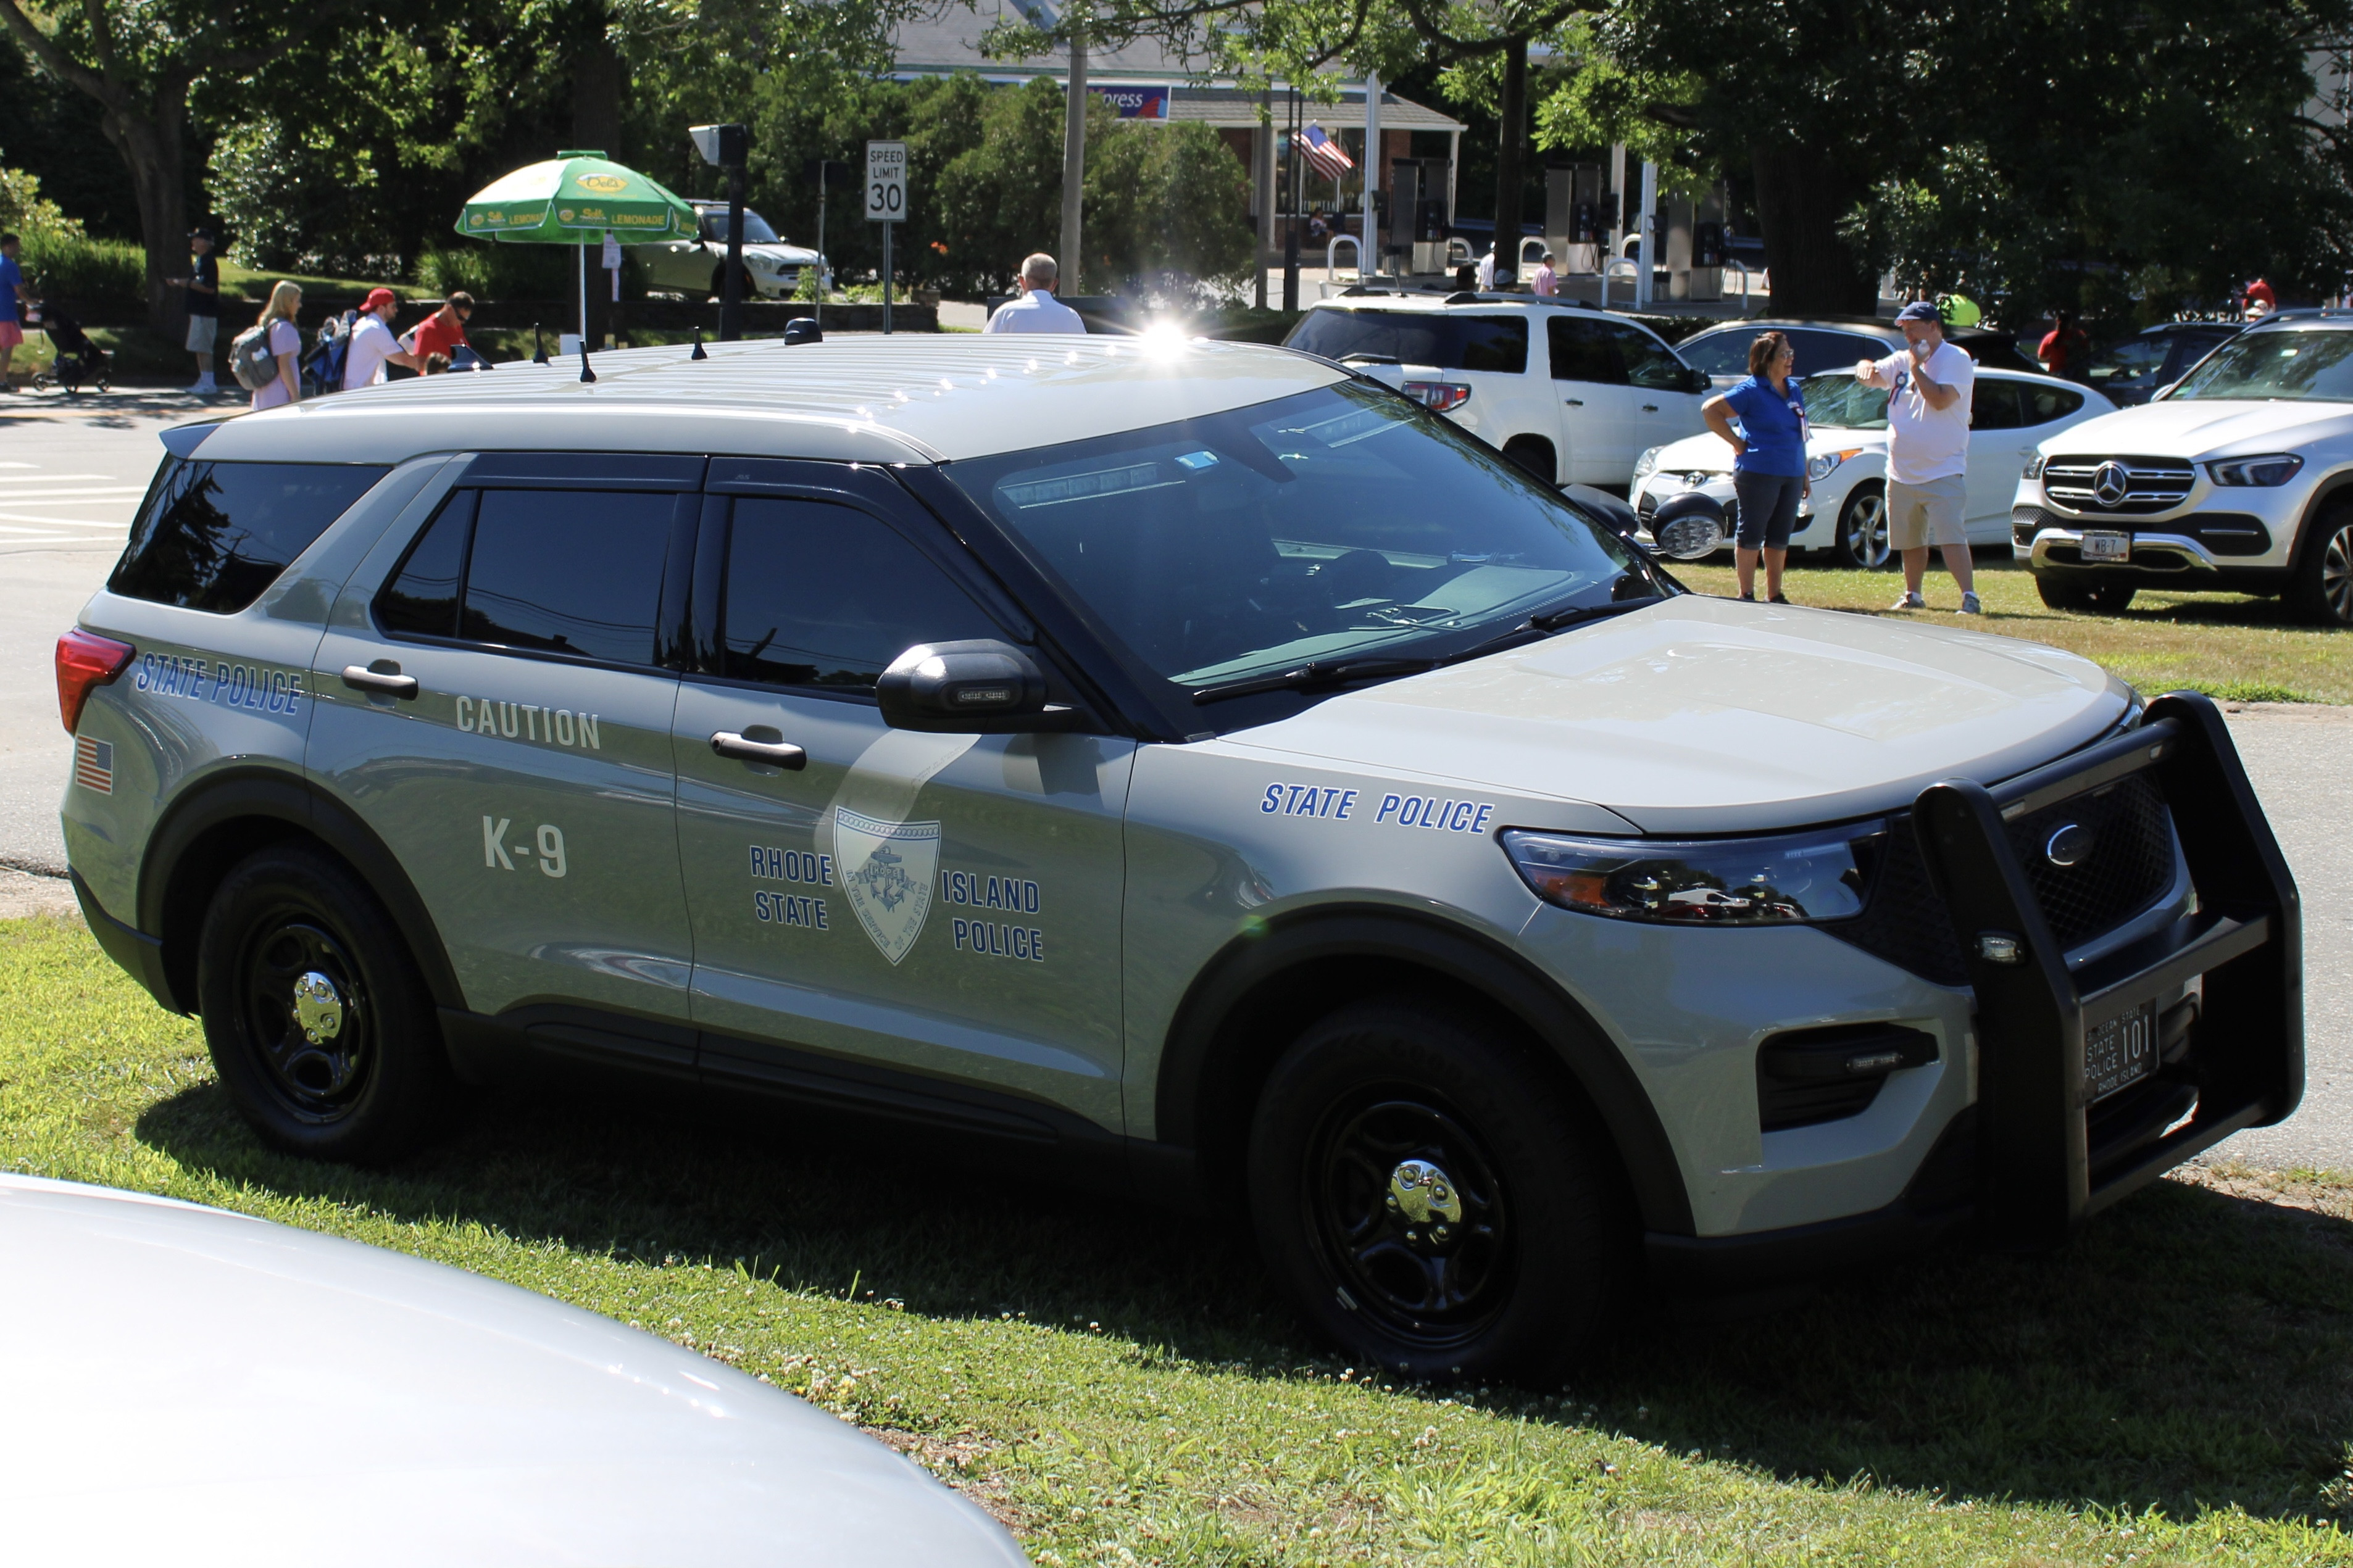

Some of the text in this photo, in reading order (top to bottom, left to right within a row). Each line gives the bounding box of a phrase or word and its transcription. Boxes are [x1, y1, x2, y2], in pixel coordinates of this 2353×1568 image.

[870, 150, 904, 163] SPEED
[873, 167, 899, 179] LIMIT
[870, 183, 901, 212] 30
[611, 214, 665, 225] LEMONADE
[136, 651, 302, 716] STATE POLICE
[456, 695, 601, 750] CAUTION
[1259, 782, 1495, 835] STATE POLICE
[483, 815, 567, 878] K-9
[749, 845, 1040, 915] RHODE ISLAND
[874, 866, 897, 877] HOPE
[913, 882, 928, 916] STATE
[754, 891, 1044, 963] STATE POLICE
[2121, 1006, 2140, 1024] STATE
[2086, 1034, 2115, 1062] STATE
[2123, 1014, 2149, 1064] 101
[2084, 1052, 2118, 1082] POLICE
[2097, 1062, 2142, 1093] RHODE ISLAND
